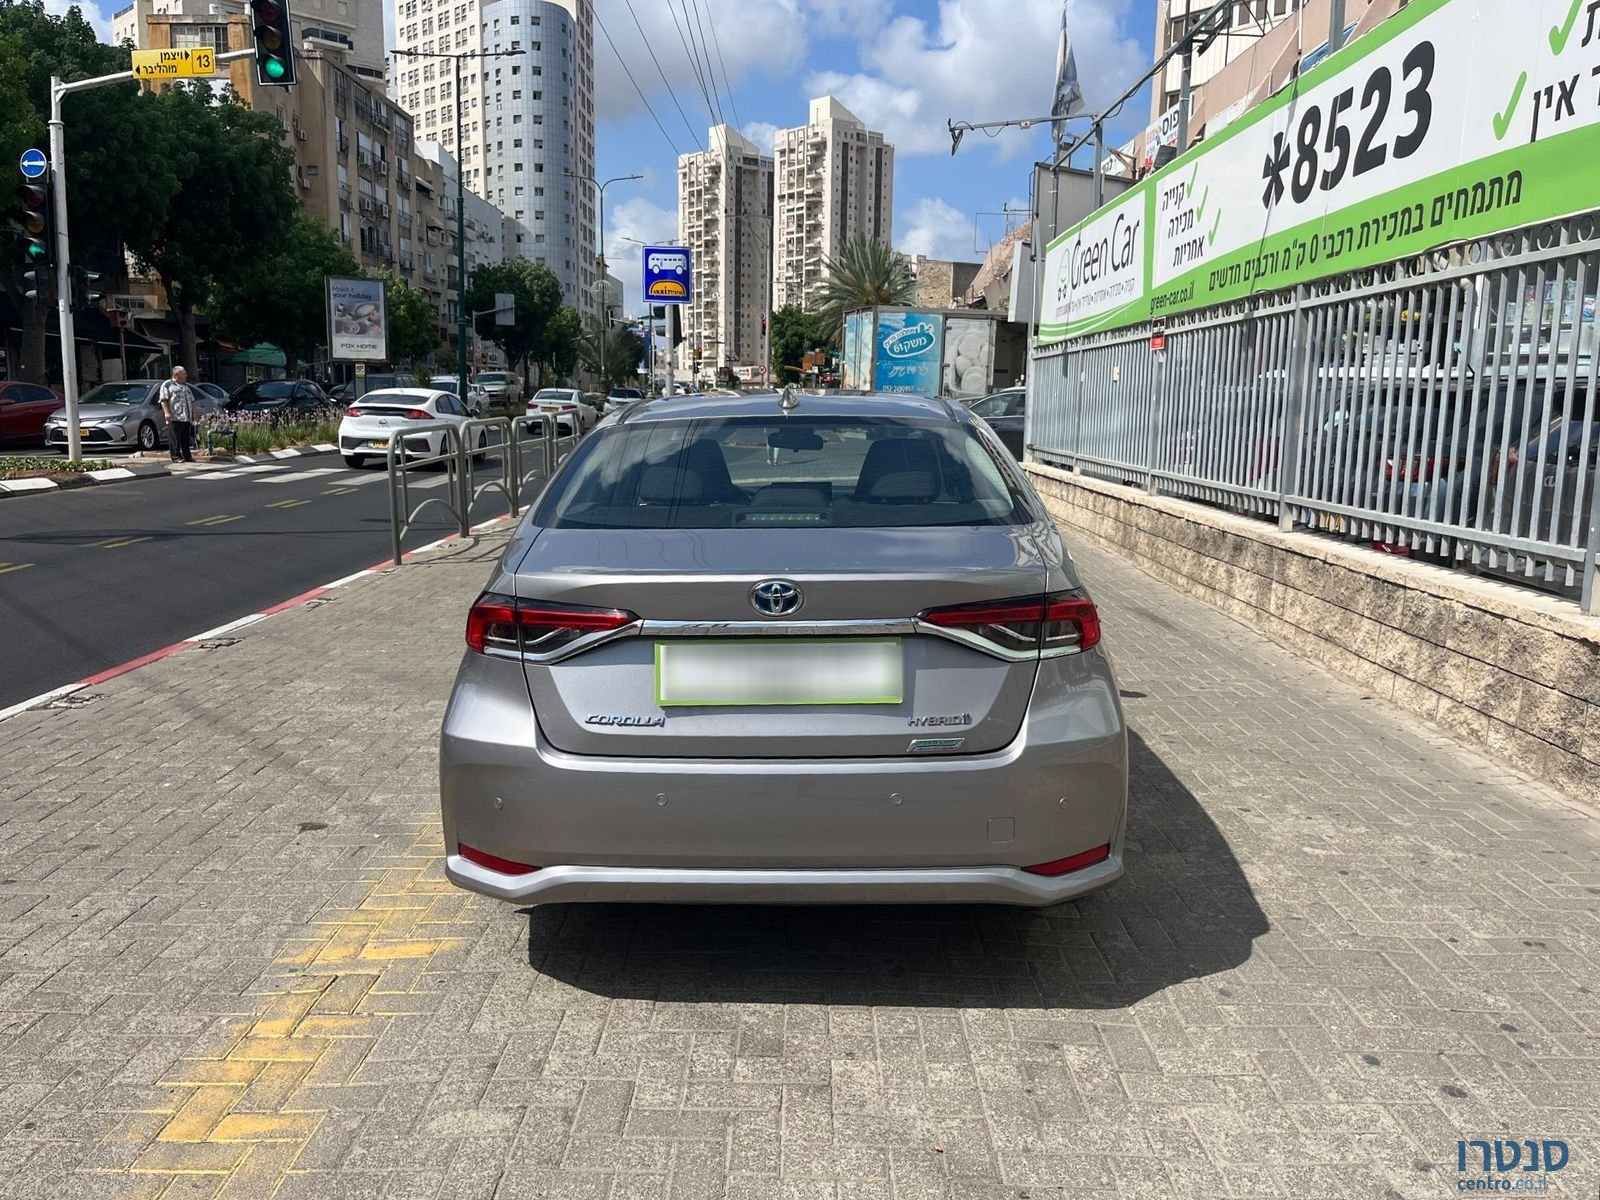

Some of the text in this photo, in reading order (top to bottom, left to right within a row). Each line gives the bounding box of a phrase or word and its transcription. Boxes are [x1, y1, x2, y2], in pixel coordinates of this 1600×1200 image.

[143, 62, 177, 75] מוהליבר
[160, 51, 183, 63] ויצמן
[196, 54, 210, 68] 13
[1530, 73, 1580, 144] אין
[1162, 181, 1185, 212] קנייה
[1430, 169, 1523, 228] מתמחים
[1168, 208, 1194, 238] מכירה
[1356, 202, 1424, 250] במכירת
[1071, 213, 1140, 290] Green Car
[1173, 235, 1205, 267] אחריות
[1322, 226, 1354, 260] רכבי
[1208, 263, 1241, 292] חדשים
[1243, 249, 1280, 281] ורכבים
[332, 291, 347, 300] your
[1150, 280, 1195, 315] green-car.co.il
[585, 714, 666, 728] COROLLA
[907, 716, 962, 727] HYBRID
